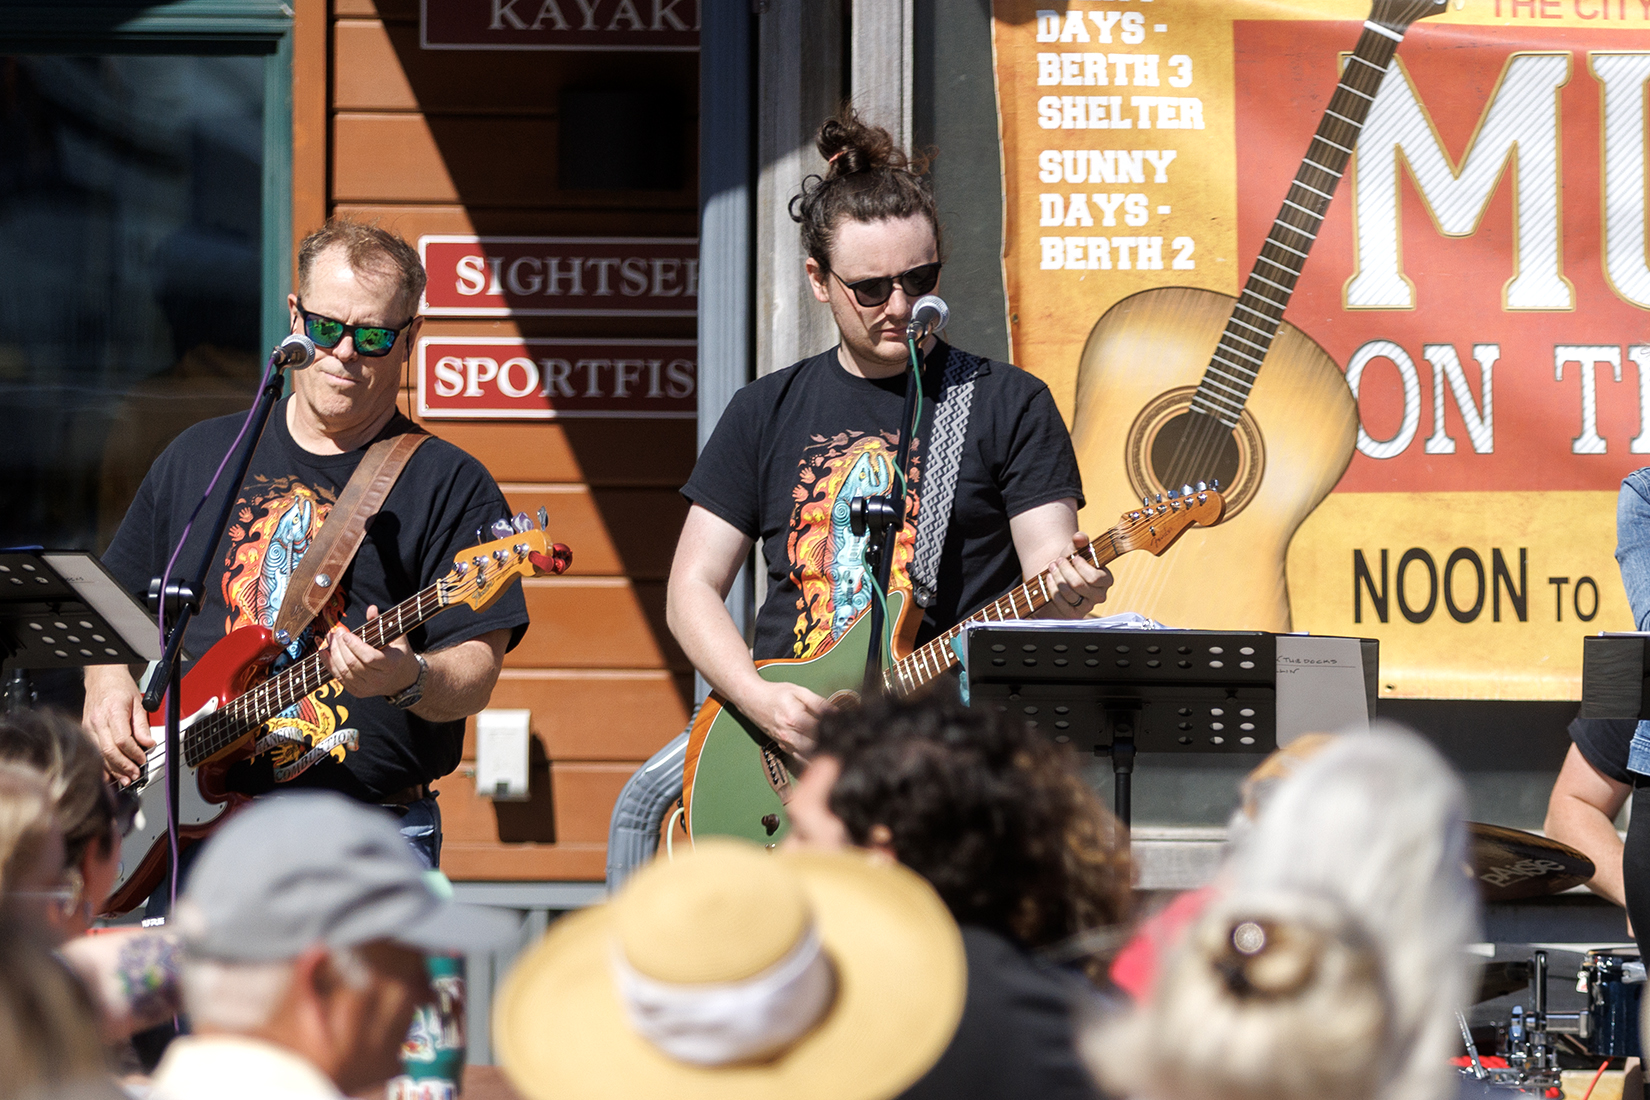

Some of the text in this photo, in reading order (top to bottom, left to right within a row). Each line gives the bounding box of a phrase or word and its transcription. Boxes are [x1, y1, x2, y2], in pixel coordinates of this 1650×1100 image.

[487, 0, 700, 31] KAYAK
[1036, 10, 1145, 44] DAYS
[1494, 0, 1563, 19] THE
[1037, 52, 1193, 88] BERTH 3
[1037, 95, 1206, 130] SHELTER
[1038, 149, 1178, 184] SUNNY
[1039, 193, 1150, 228] DAYS
[1039, 236, 1196, 271] BERTH 2
[434, 356, 697, 398] SPORTFIS
[1345, 339, 1501, 460] ON
[1353, 546, 1529, 624] NOON
[1548, 576, 1599, 622] TO
[255, 727, 304, 754] TANEOUS
[274, 729, 356, 781] COMBUSTION
